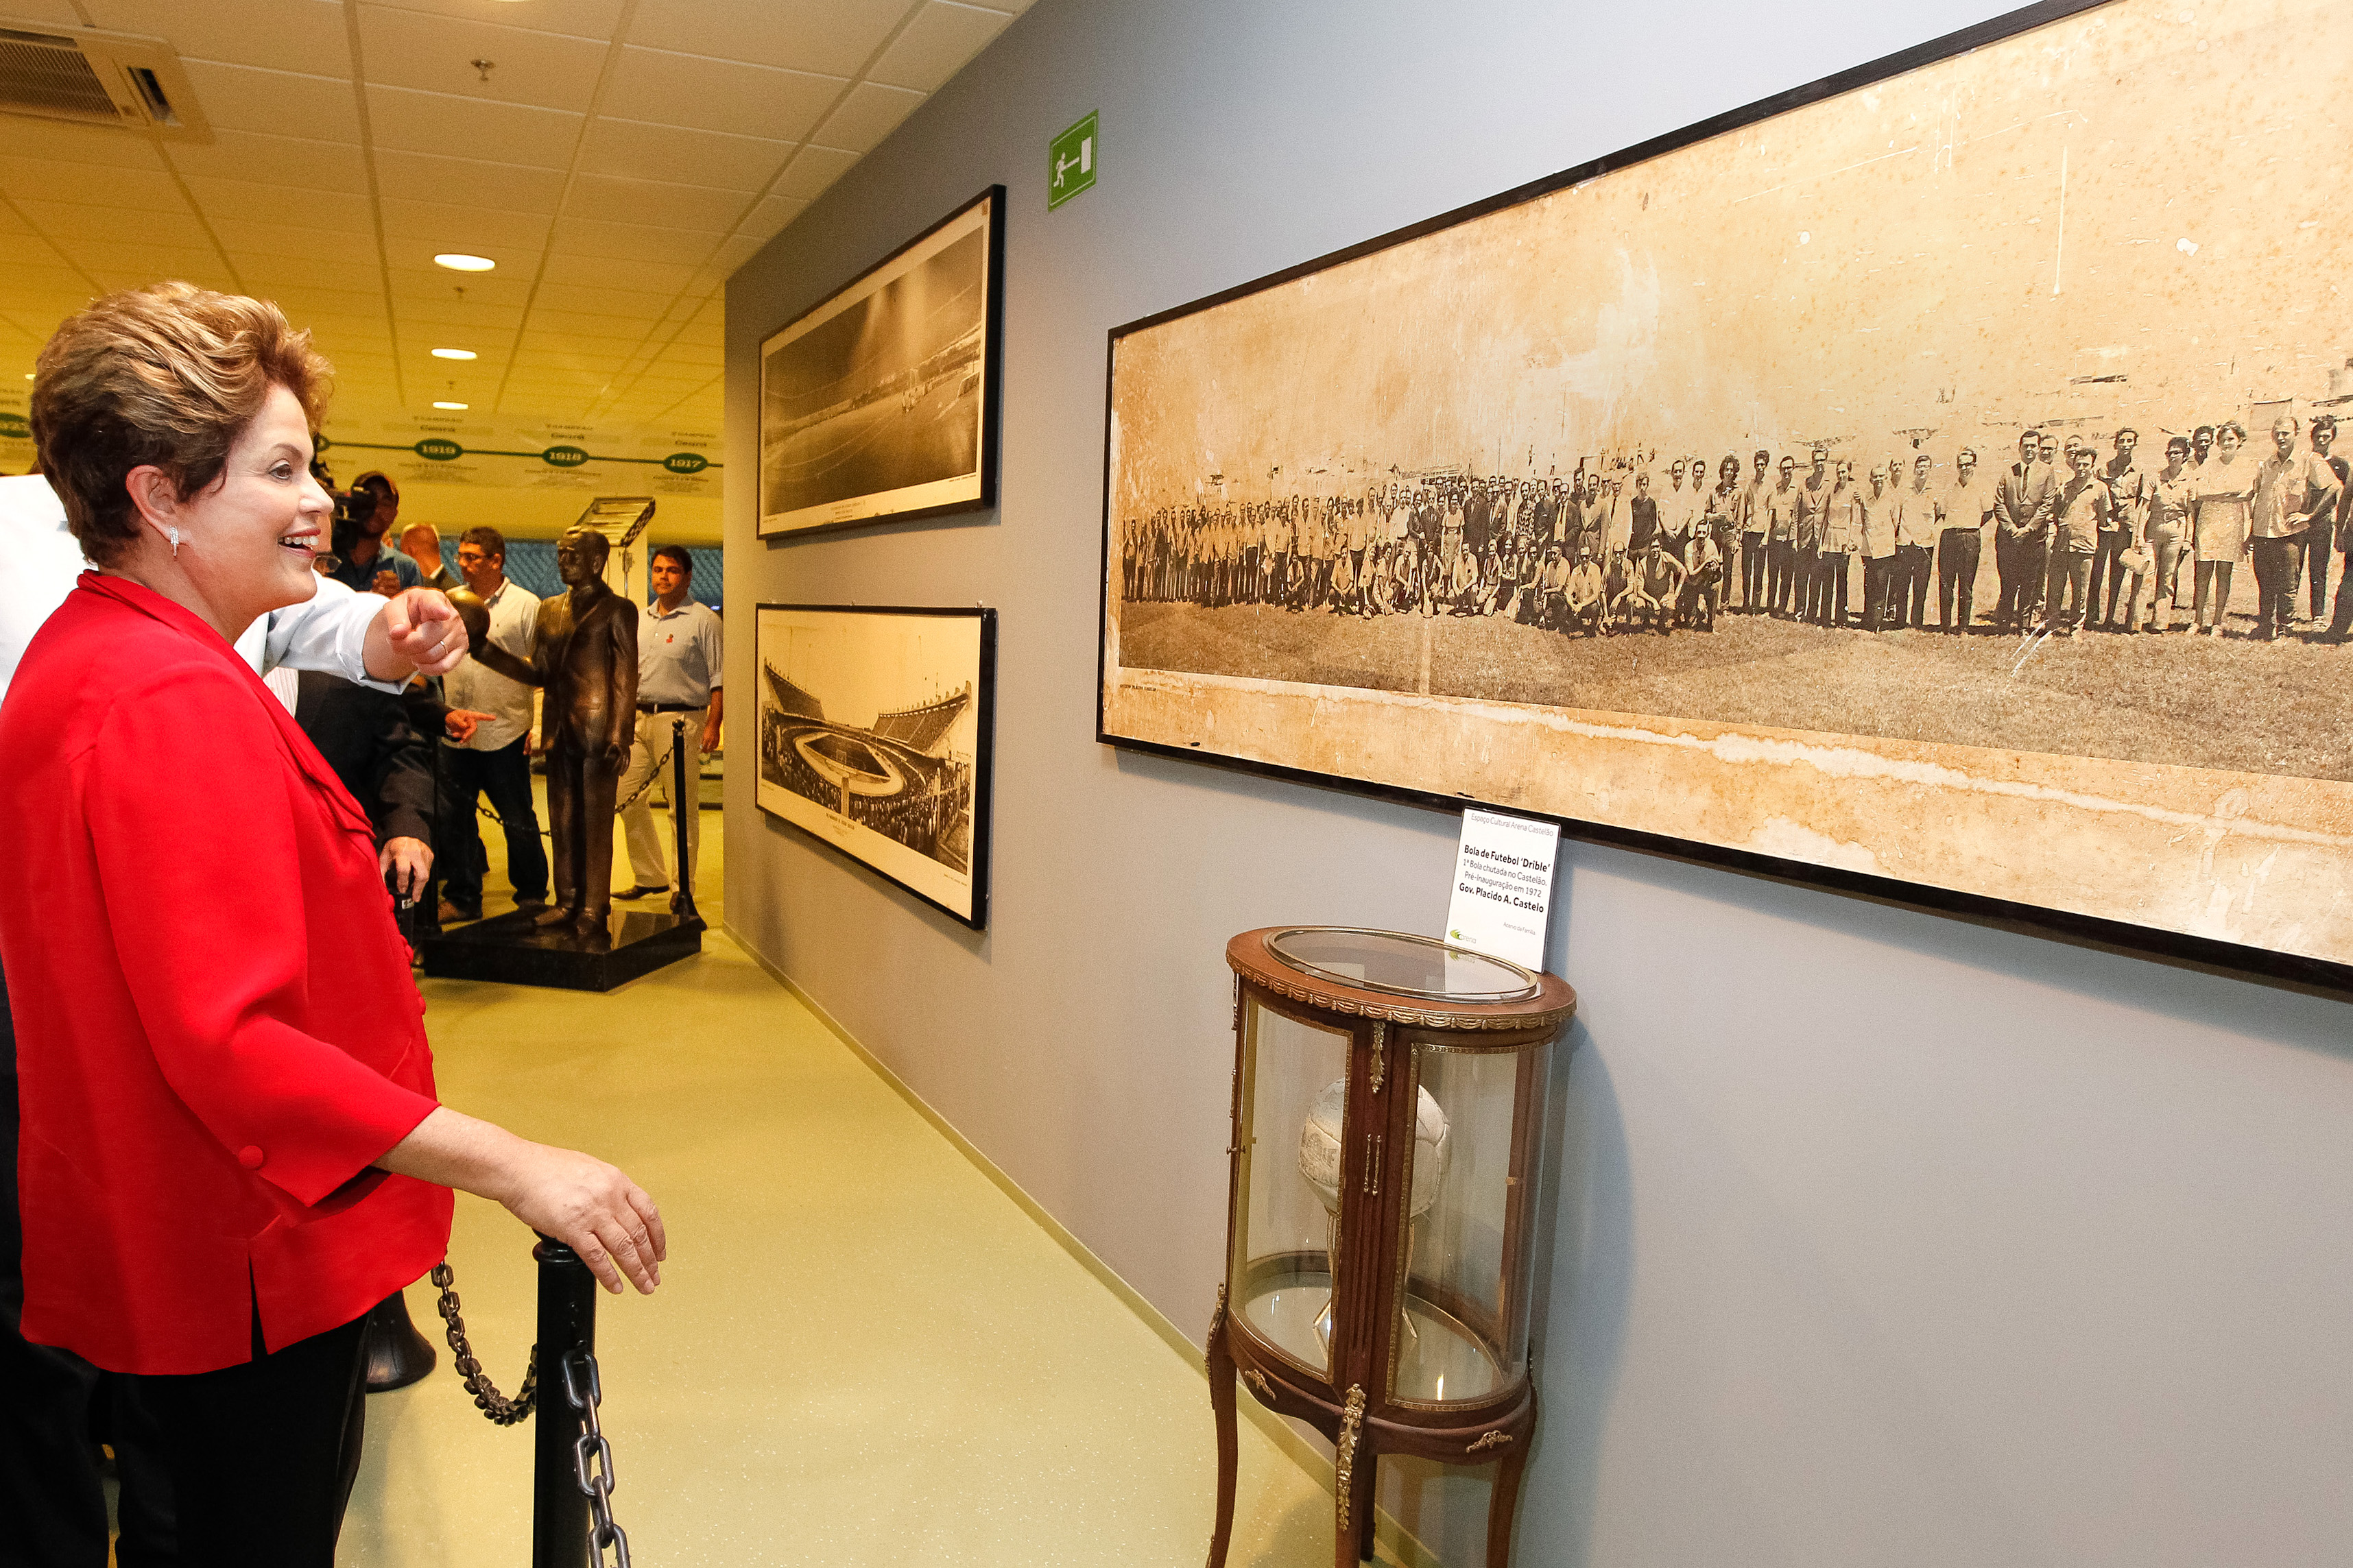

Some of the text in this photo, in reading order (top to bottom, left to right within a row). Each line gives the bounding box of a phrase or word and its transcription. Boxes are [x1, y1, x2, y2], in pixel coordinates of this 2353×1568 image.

[670, 458, 702, 468] 1917
[1471, 813, 1553, 836] Espaço Cultural Arena Castelão
[1464, 845, 1479, 856] Bola
[1481, 849, 1490, 858] de
[1490, 851, 1519, 865] Futebol
[1465, 871, 1542, 897] Pré-Inauguração em 1972
[1470, 860, 1483, 870] Bola
[1483, 863, 1507, 876] chutada
[1517, 872, 1547, 886] Castelão.
[1459, 882, 1544, 913] Gov. Placido A. Castelo
